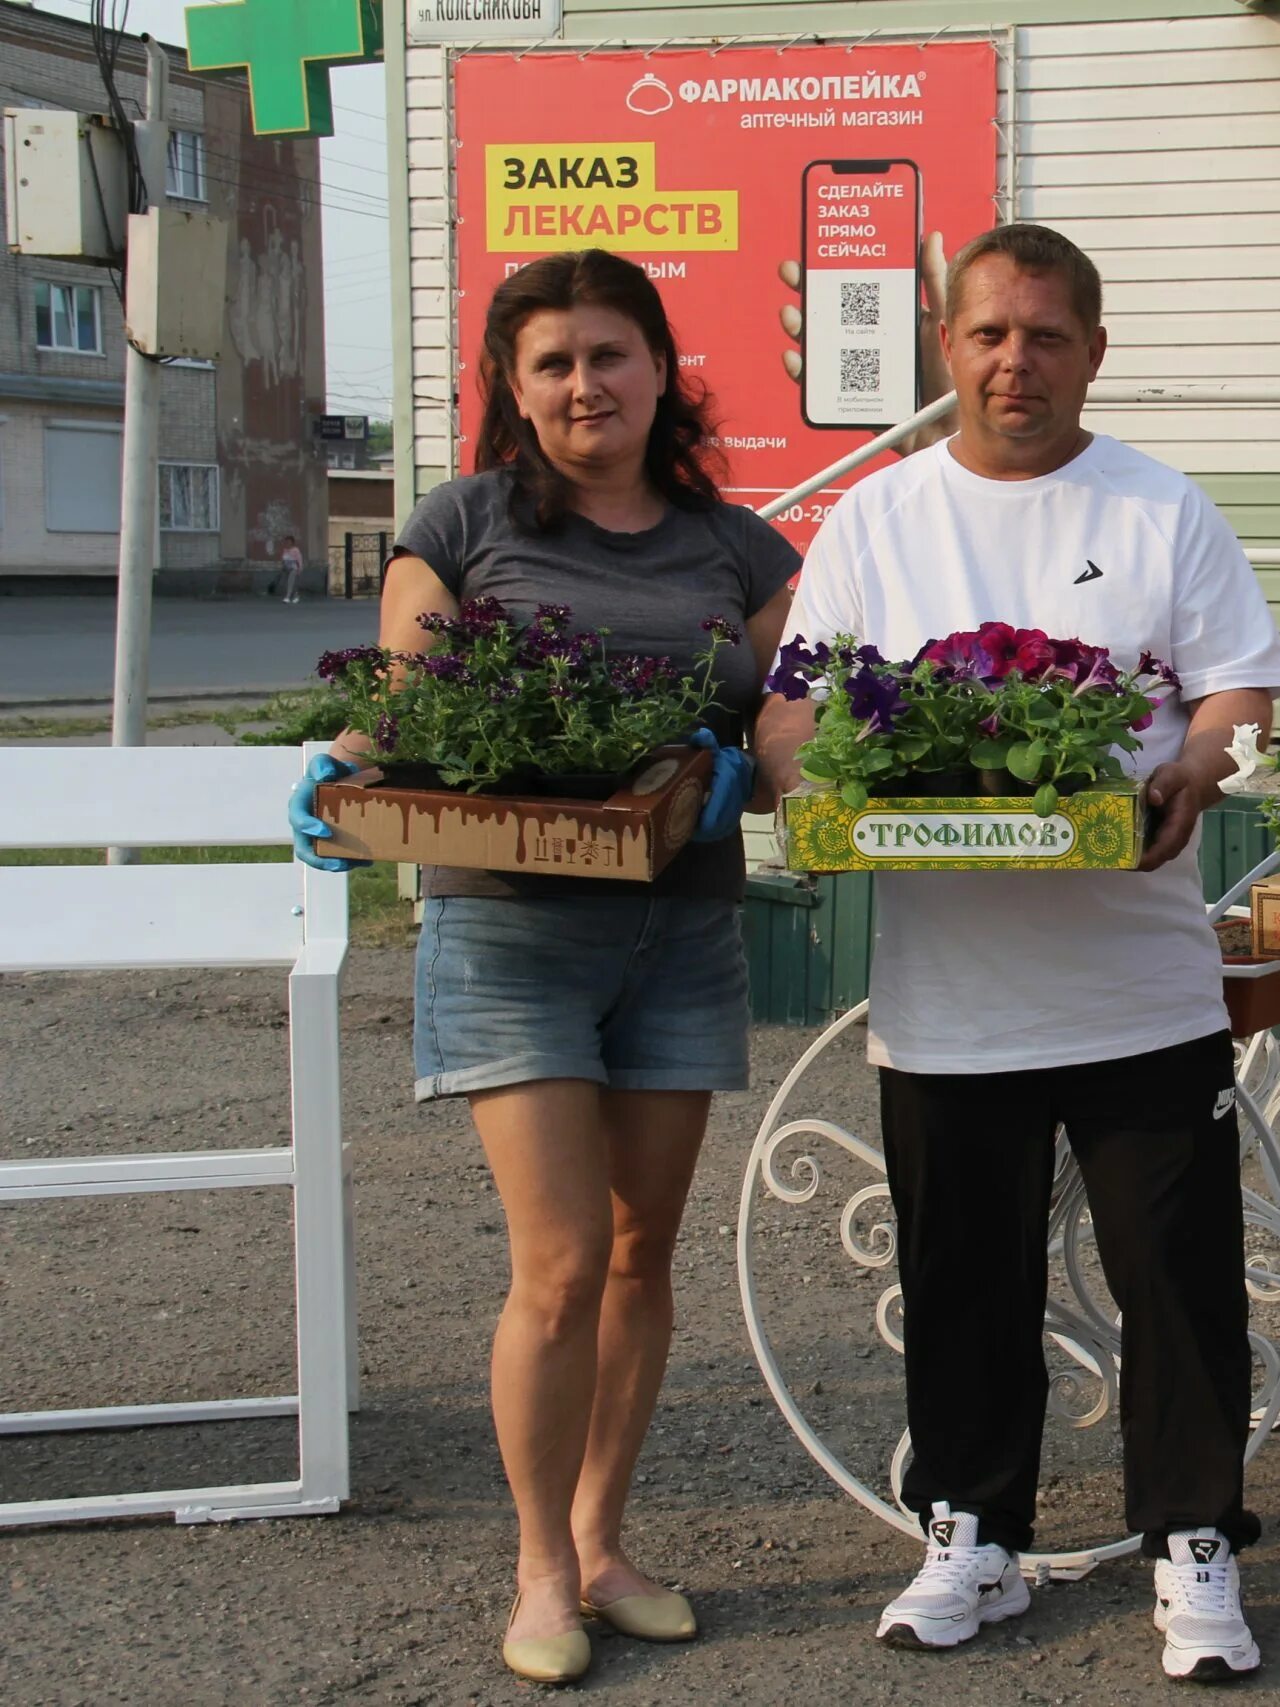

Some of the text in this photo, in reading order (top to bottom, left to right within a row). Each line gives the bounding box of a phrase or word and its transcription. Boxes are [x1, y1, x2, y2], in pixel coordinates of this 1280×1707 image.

[418, 0, 541, 22] ул. КОЛЕСНИКОВА
[741, 107, 923, 130] аптечный магазин
[504, 157, 639, 189] ЗАКАЗ
[818, 182, 904, 201] СДЕЛАЙТЕ
[504, 204, 723, 237] ЛЕКАРСТВ
[818, 204, 870, 218] ЗАКАЗ
[818, 224, 876, 238] ПРЯМО
[818, 241, 886, 259] СЕЙЧАС!
[724, 437, 787, 450] выдачи
[869, 822, 1058, 848] ТРОФИМОВ
